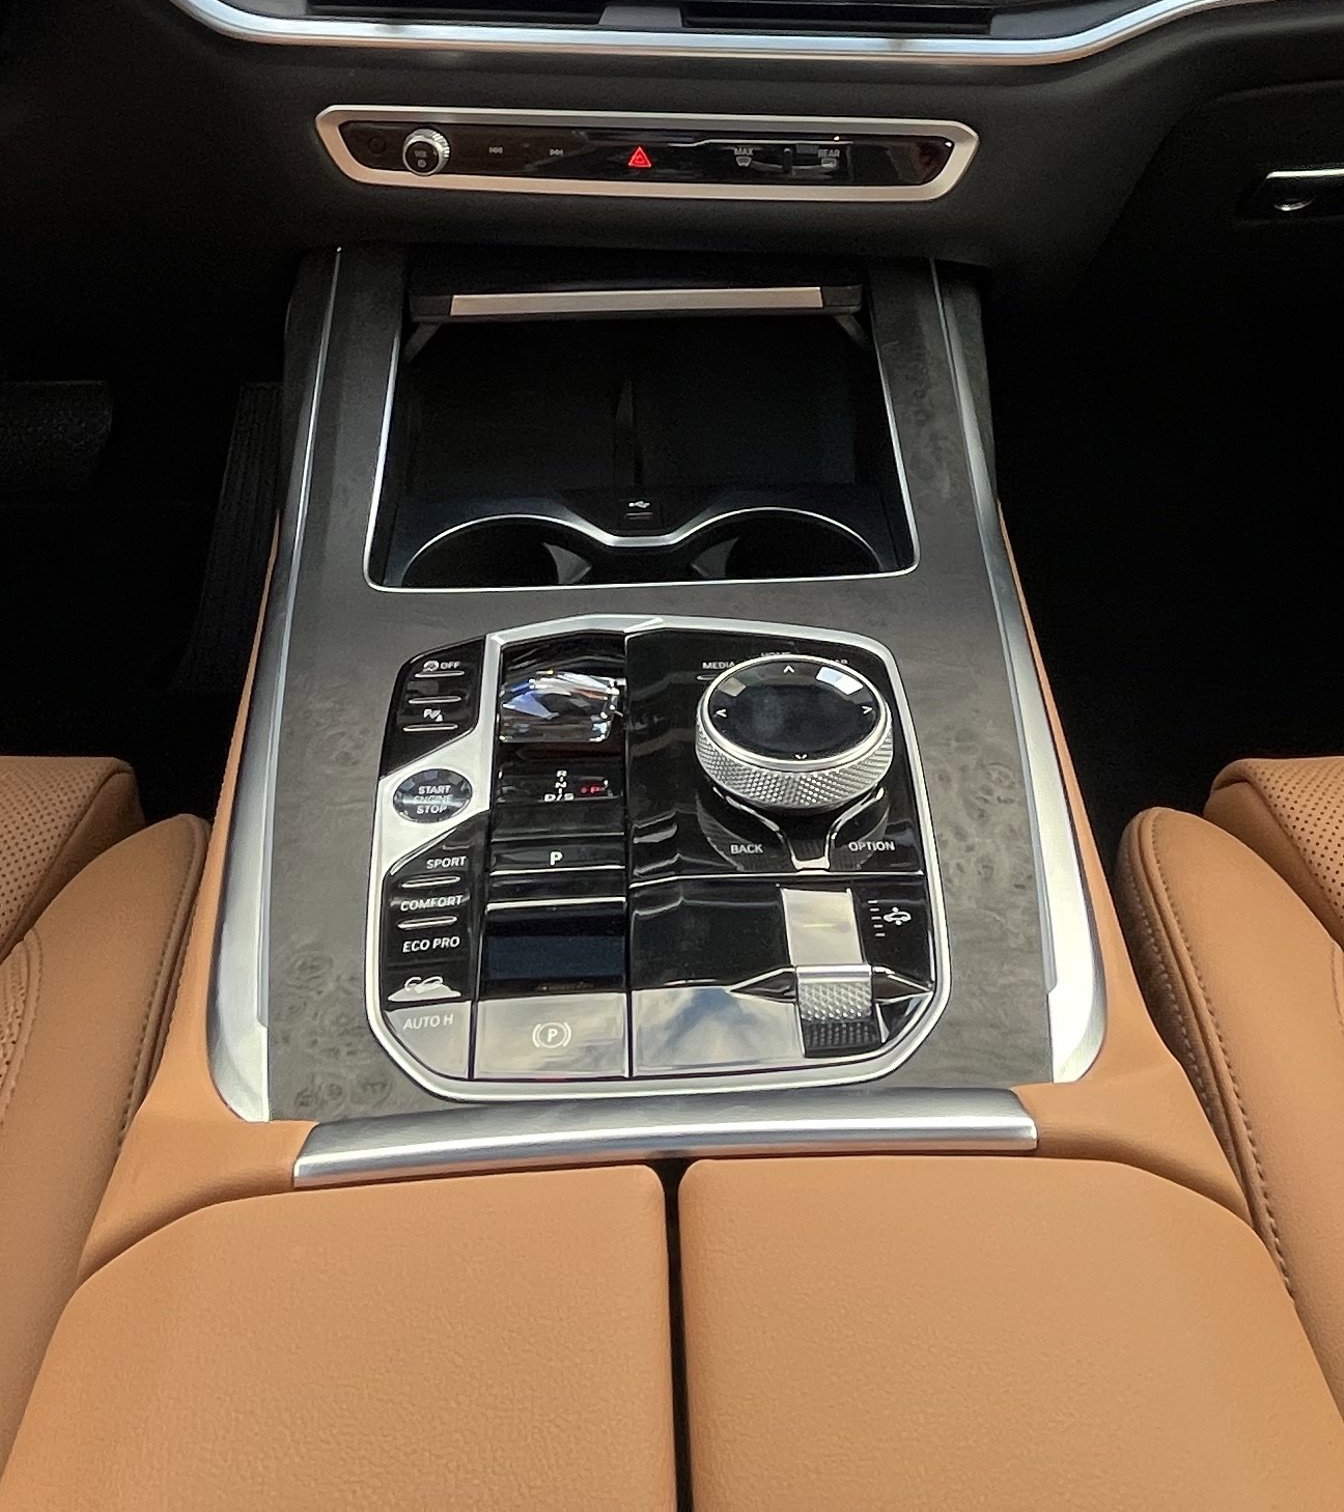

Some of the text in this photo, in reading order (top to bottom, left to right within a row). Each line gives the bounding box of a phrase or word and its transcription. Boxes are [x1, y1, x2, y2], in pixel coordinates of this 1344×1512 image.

[440, 661, 460, 670] OFF
[702, 661, 735, 670] MEDIA
[418, 784, 451, 795] START
[416, 804, 447, 815] STOP
[730, 843, 764, 855] BACK
[848, 840, 896, 852] OPTION
[425, 855, 467, 870] SPORT
[550, 851, 563, 866] P
[400, 894, 464, 912] COMFORT
[402, 935, 461, 953] ECO PRO
[403, 1013, 454, 1030] AUTO H
